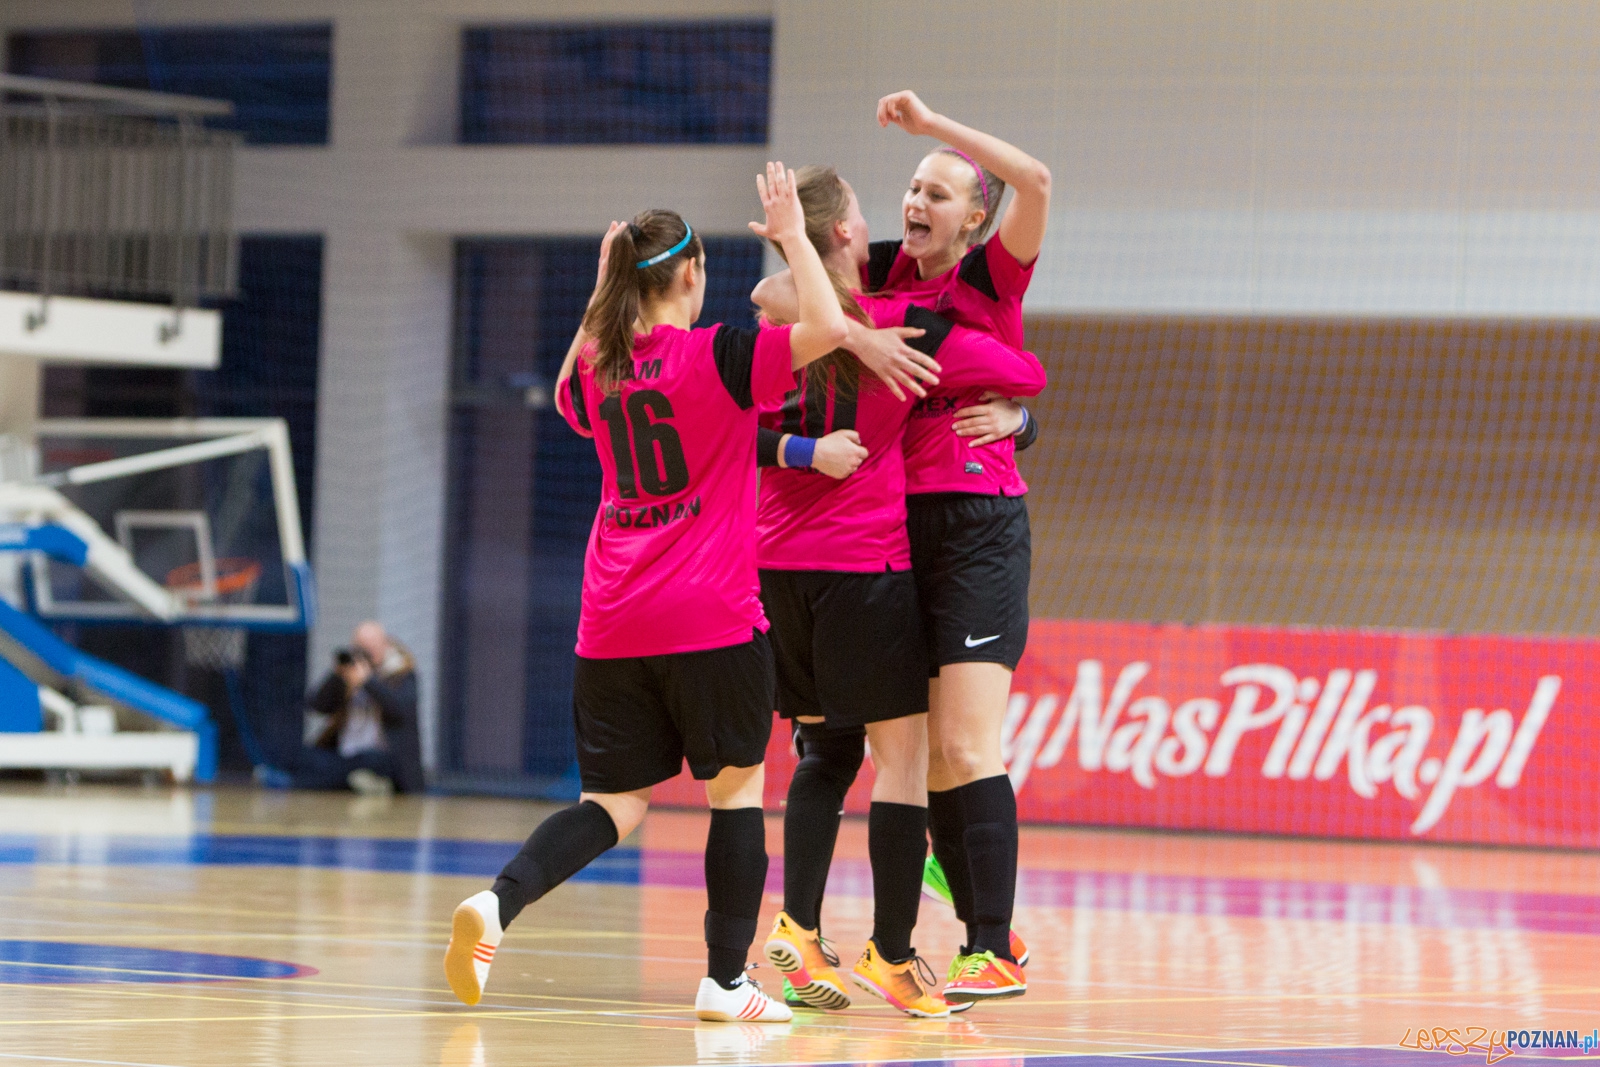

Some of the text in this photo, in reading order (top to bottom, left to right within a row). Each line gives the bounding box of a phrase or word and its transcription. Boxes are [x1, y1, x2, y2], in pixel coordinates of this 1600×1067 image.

[612, 359, 663, 382] AM
[599, 389, 690, 499] 16
[605, 495, 701, 528] POZNAN
